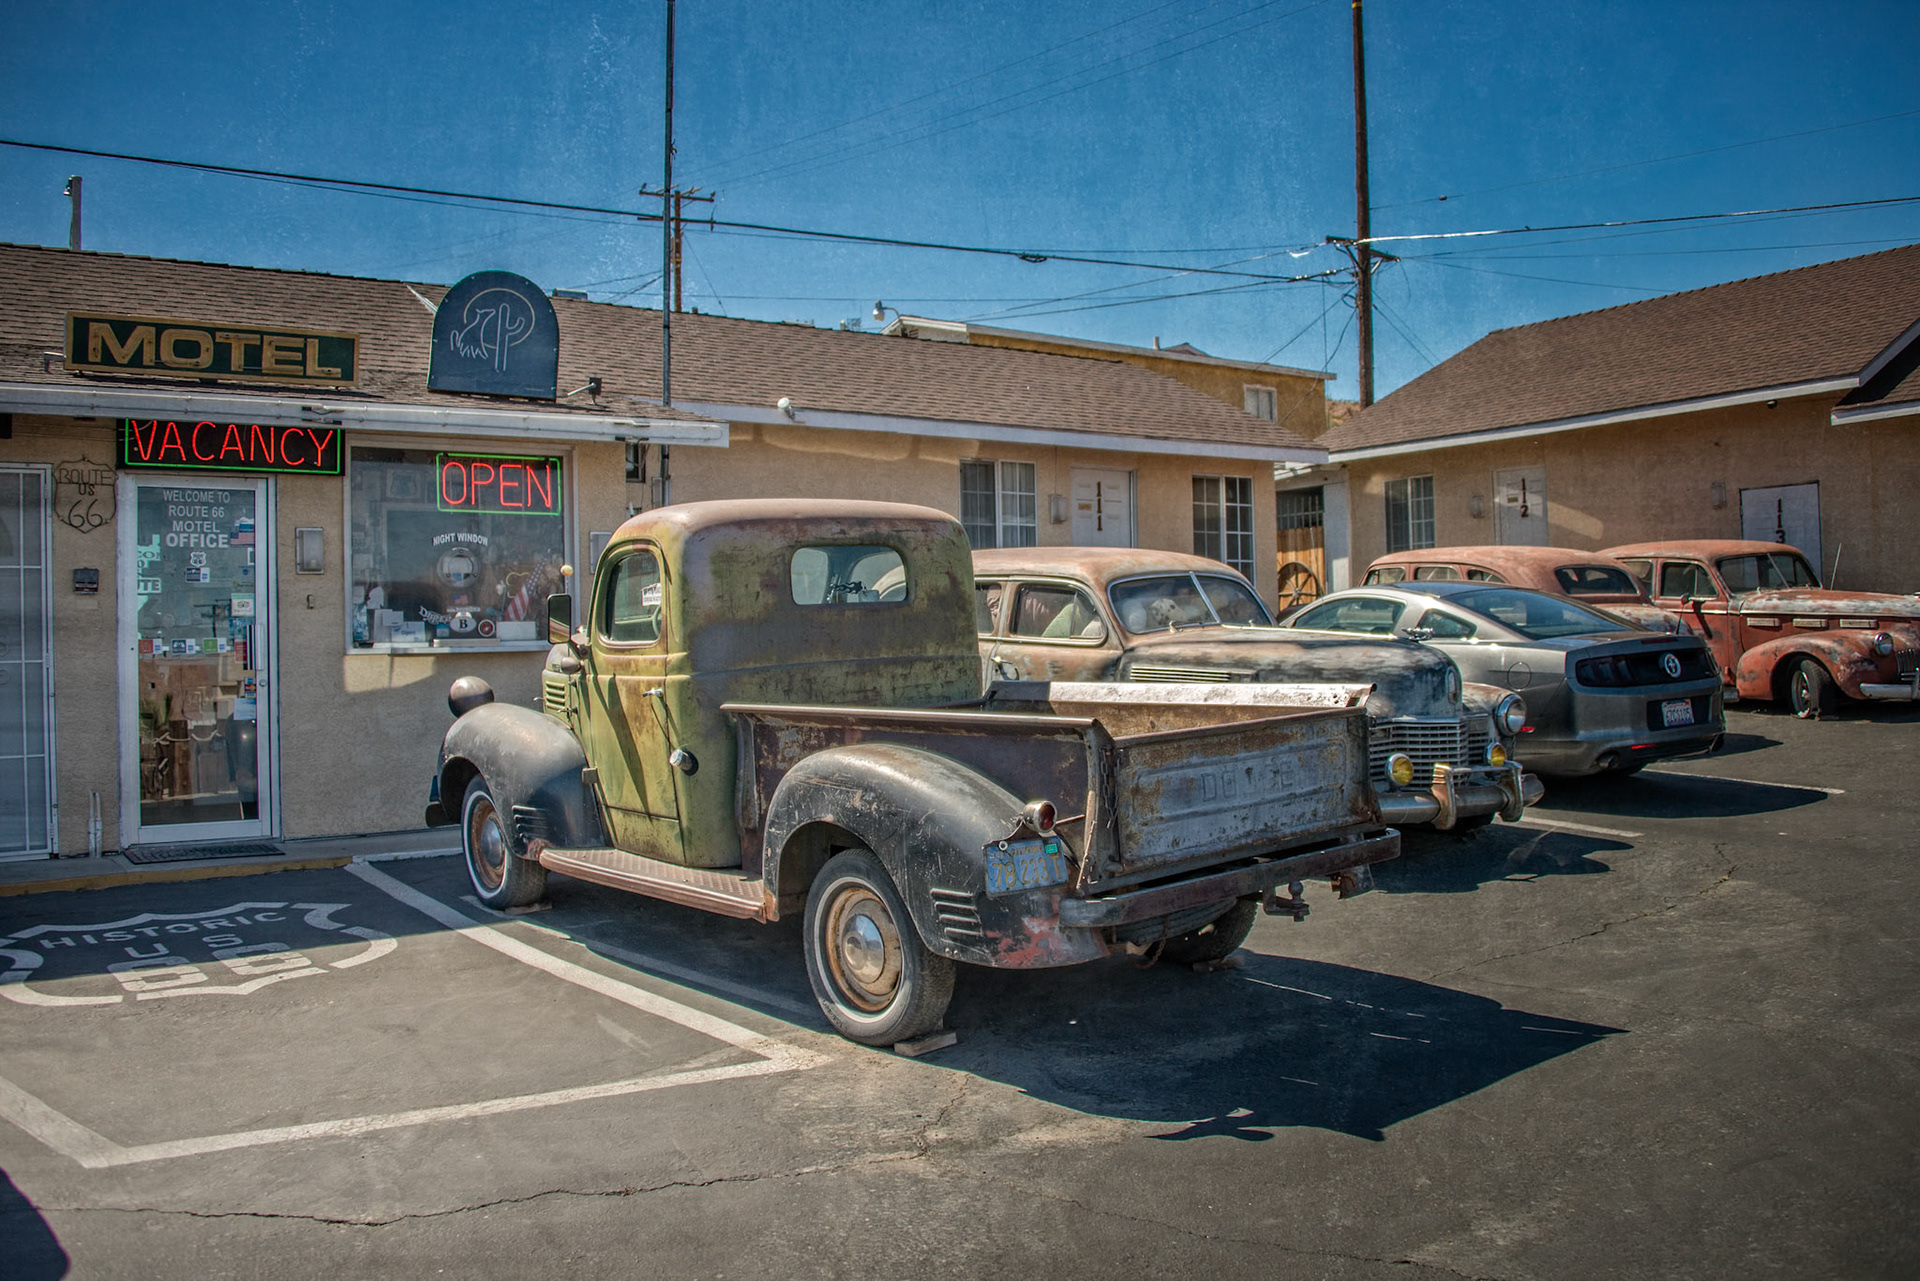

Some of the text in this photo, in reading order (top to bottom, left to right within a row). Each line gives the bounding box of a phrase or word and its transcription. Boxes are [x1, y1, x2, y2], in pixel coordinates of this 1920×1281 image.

[88, 321, 342, 378] MOTEL
[131, 419, 334, 467] VACANCY
[59, 468, 113, 485] ROUTE
[442, 461, 552, 509] OPEN
[79, 484, 95, 496] US
[163, 490, 230, 503] WELCOME TO
[1521, 478, 1529, 518] 112
[68, 499, 103, 528] 66
[168, 505, 225, 518] ROUTE 66
[1776, 498, 1785, 543] 113
[172, 520, 220, 533] MOTEL
[165, 533, 229, 548] OFFICE
[432, 532, 488, 546] NIGHT WINDOW
[459, 619, 468, 629] B
[39, 911, 287, 949] HISTORIC
[107, 942, 312, 992] 66
